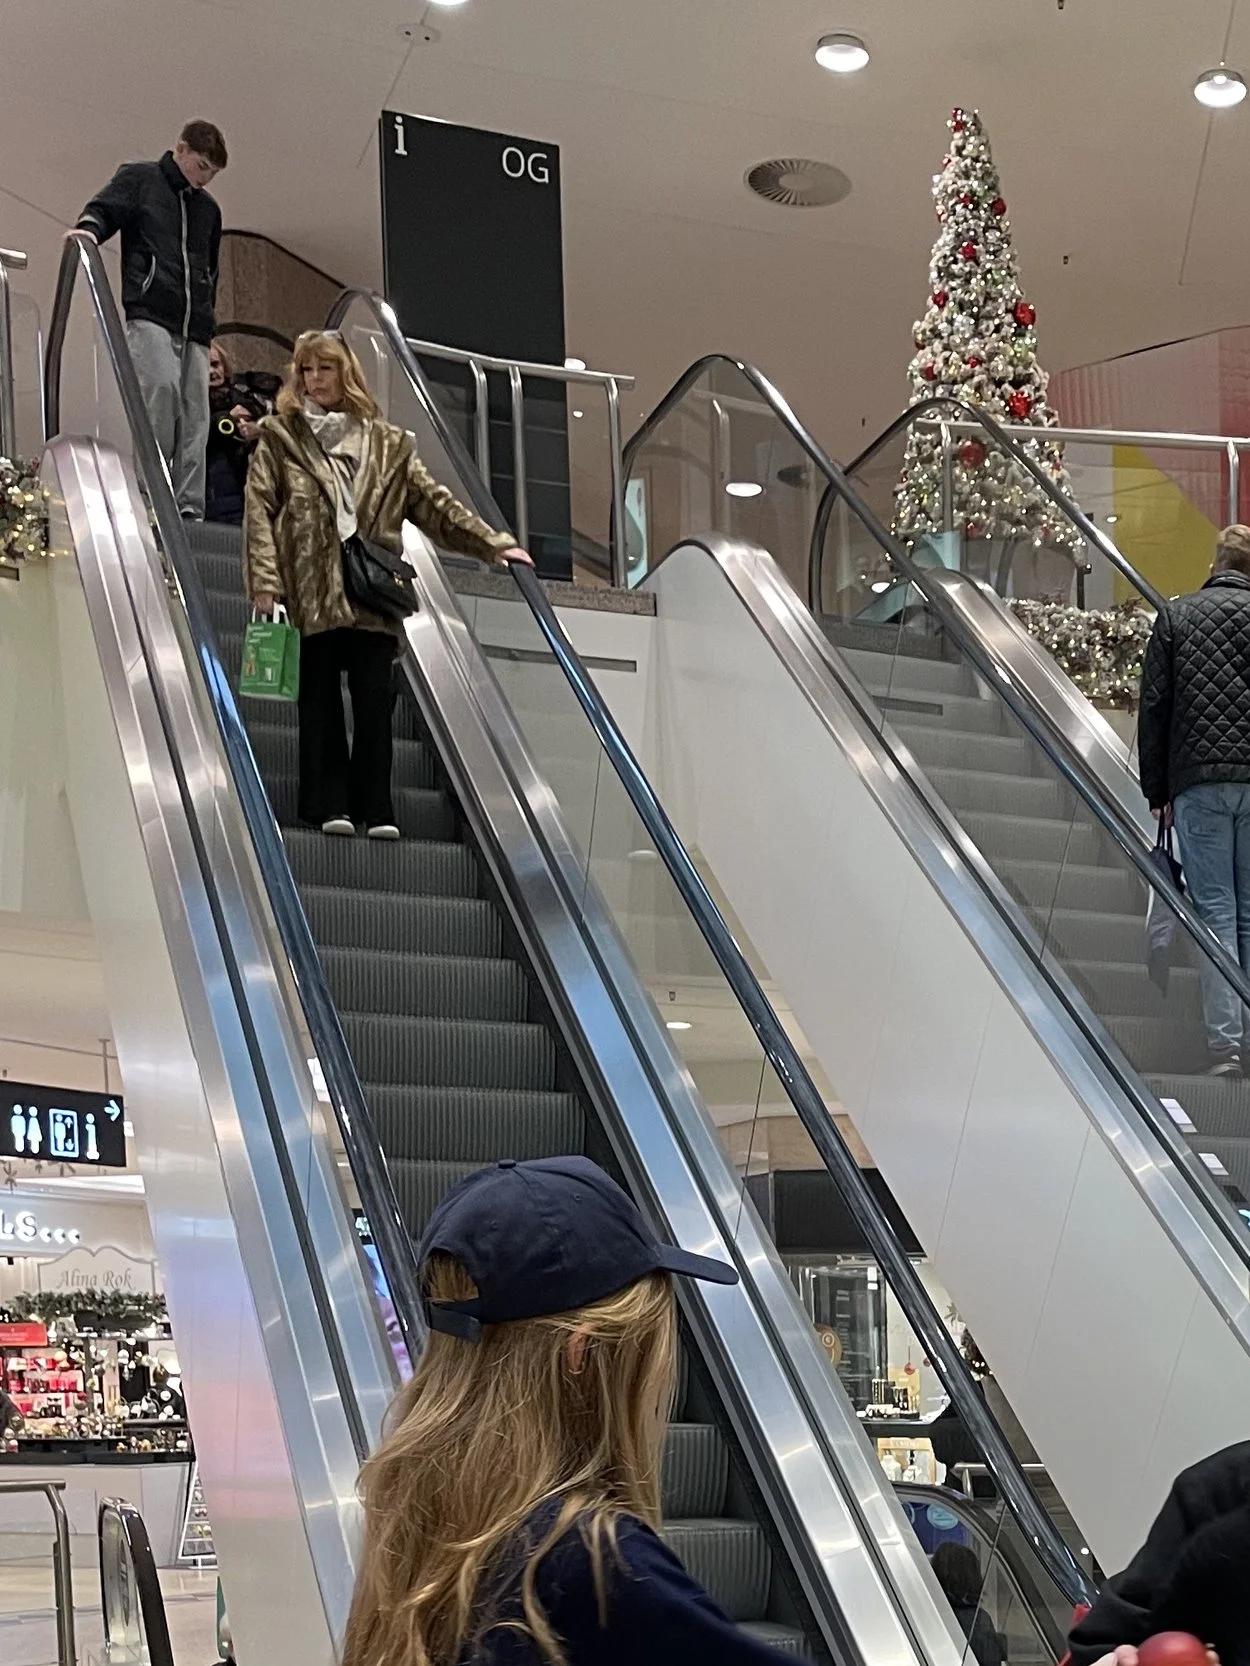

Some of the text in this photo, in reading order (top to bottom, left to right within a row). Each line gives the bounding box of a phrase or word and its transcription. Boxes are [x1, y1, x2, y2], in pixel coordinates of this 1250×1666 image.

[502, 147, 549, 184] OG
[56, 1267, 136, 1290] Alina Rok
